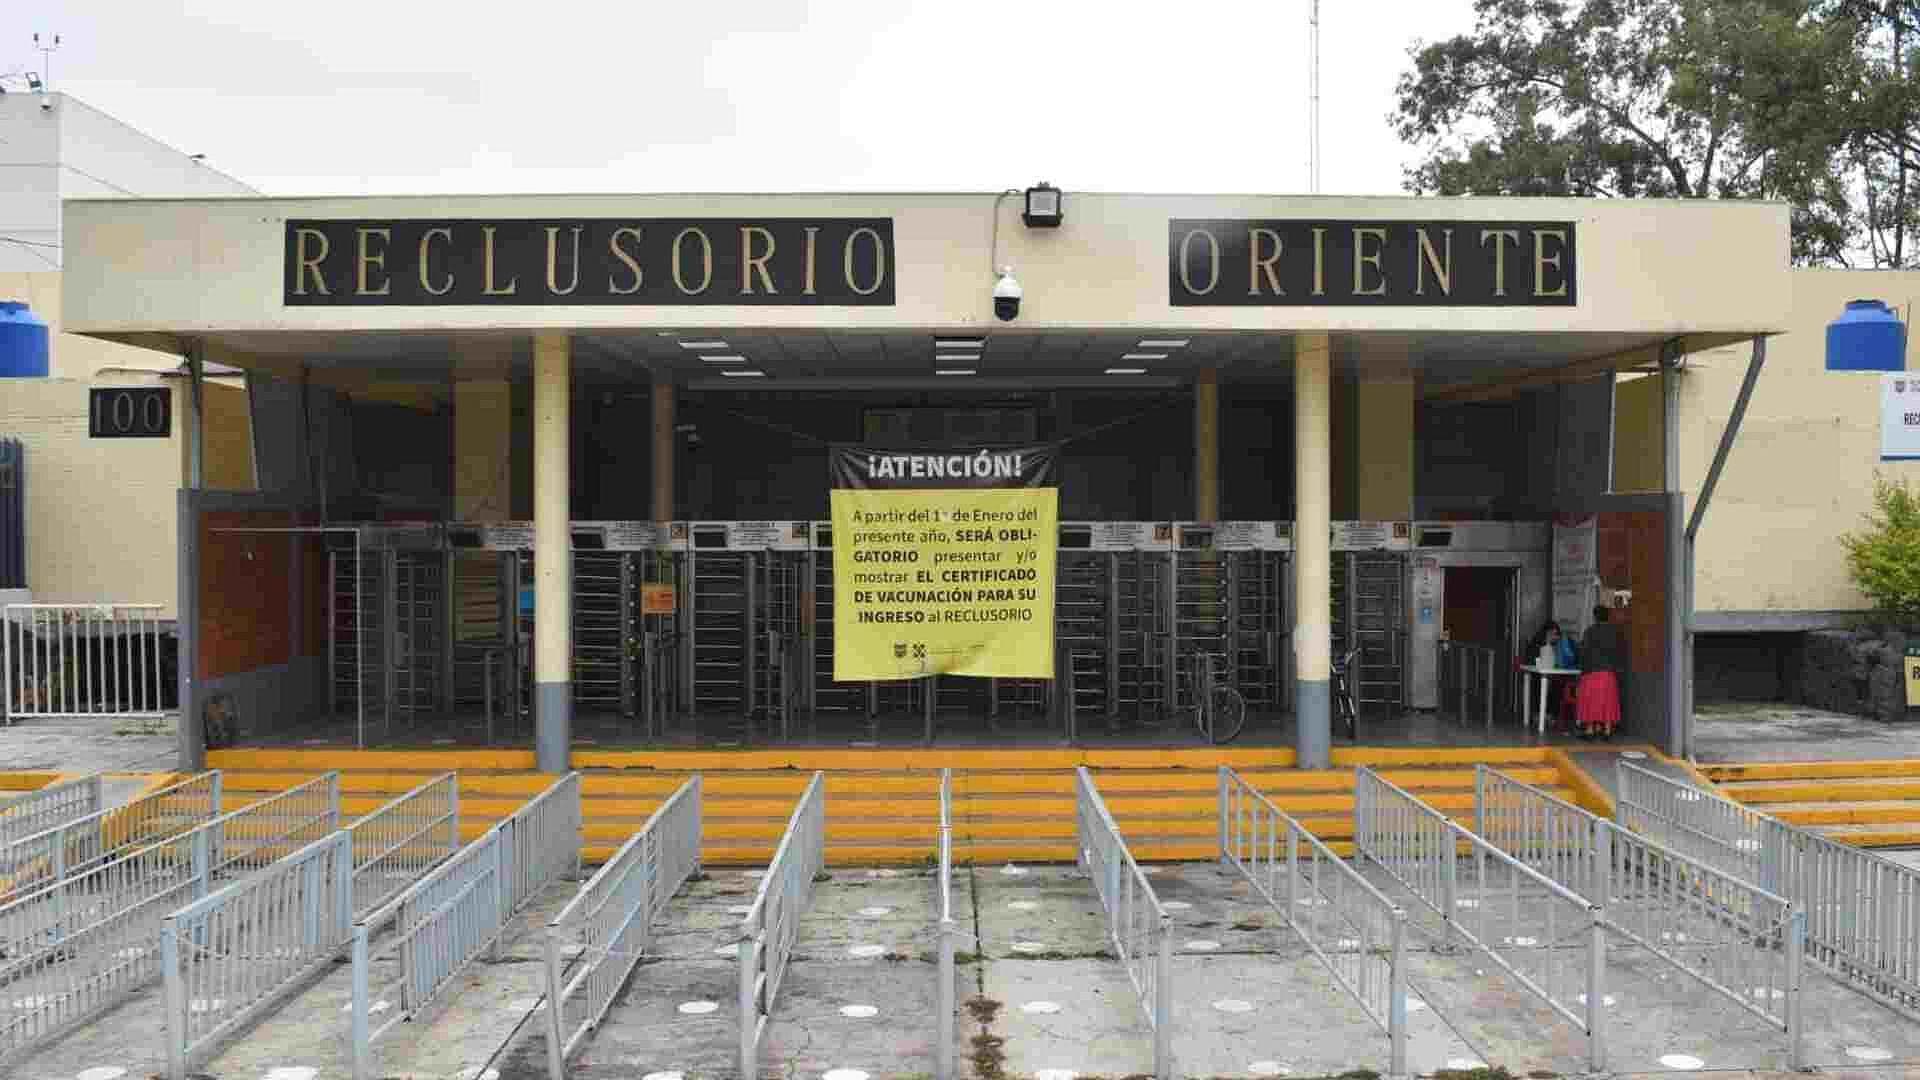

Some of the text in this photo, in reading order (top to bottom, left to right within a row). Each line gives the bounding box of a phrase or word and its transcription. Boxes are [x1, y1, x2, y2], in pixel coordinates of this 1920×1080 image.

[291, 226, 1568, 298] RECLUSORIO ORIENTE
[95, 391, 164, 433] 100
[867, 449, 1022, 478] ¡ATENCIÓN!
[853, 510, 862, 522] A
[864, 508, 904, 524] partir
[907, 508, 929, 522] del
[952, 508, 970, 522] de
[973, 508, 1014, 522] Enero
[1017, 507, 1038, 521] del
[853, 526, 1038, 545] presente año, SERÁ OBLI-
[853, 549, 1037, 564] GATORIO presentar y/o
[853, 567, 1037, 583] mostrar EL CERTIFICADO
[854, 587, 1037, 604] DE VACUNACIÓN PARA SU
[858, 608, 1033, 623] INGRESO al RECLUSORIO
